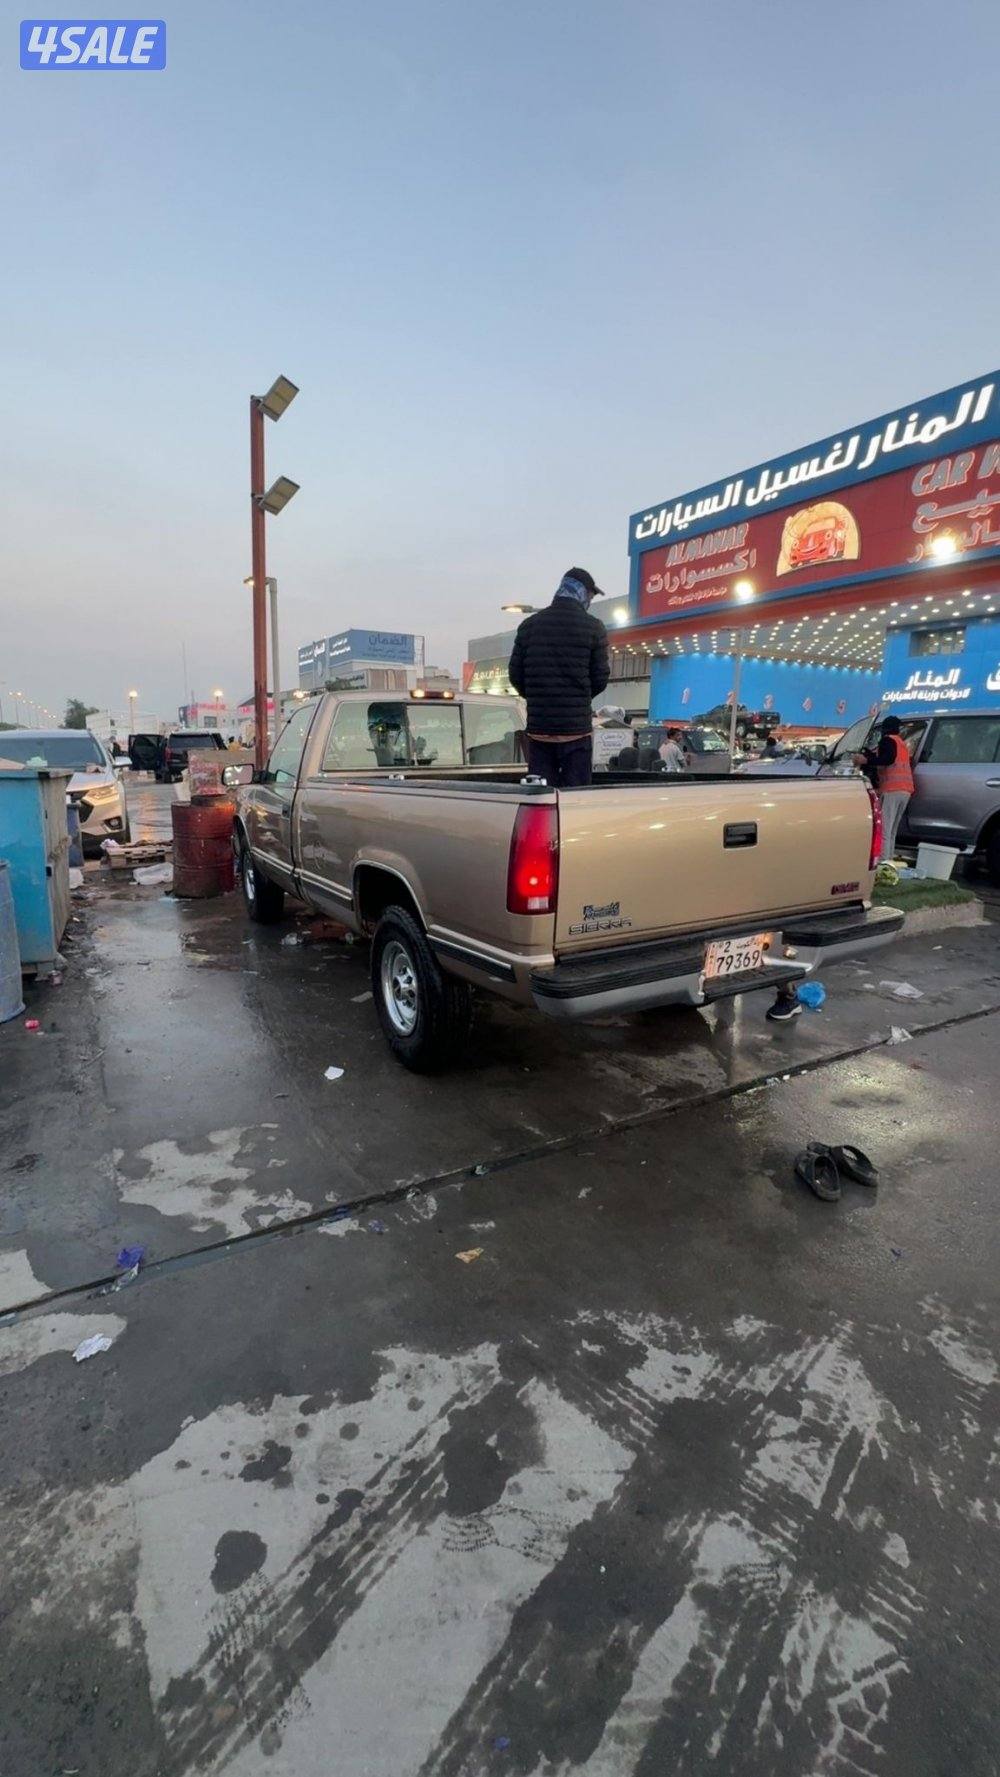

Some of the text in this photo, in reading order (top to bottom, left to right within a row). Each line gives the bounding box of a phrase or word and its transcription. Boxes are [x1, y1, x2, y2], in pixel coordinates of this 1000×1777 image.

[635, 383, 995, 540] المنار لغسيل السيارات
[911, 451, 976, 497] CAR
[665, 522, 749, 568] ALMANAR
[646, 548, 758, 594] اكسسوارات
[904, 667, 961, 691] المنار
[716, 949, 760, 974] 79369
[723, 941, 731, 953] 2
